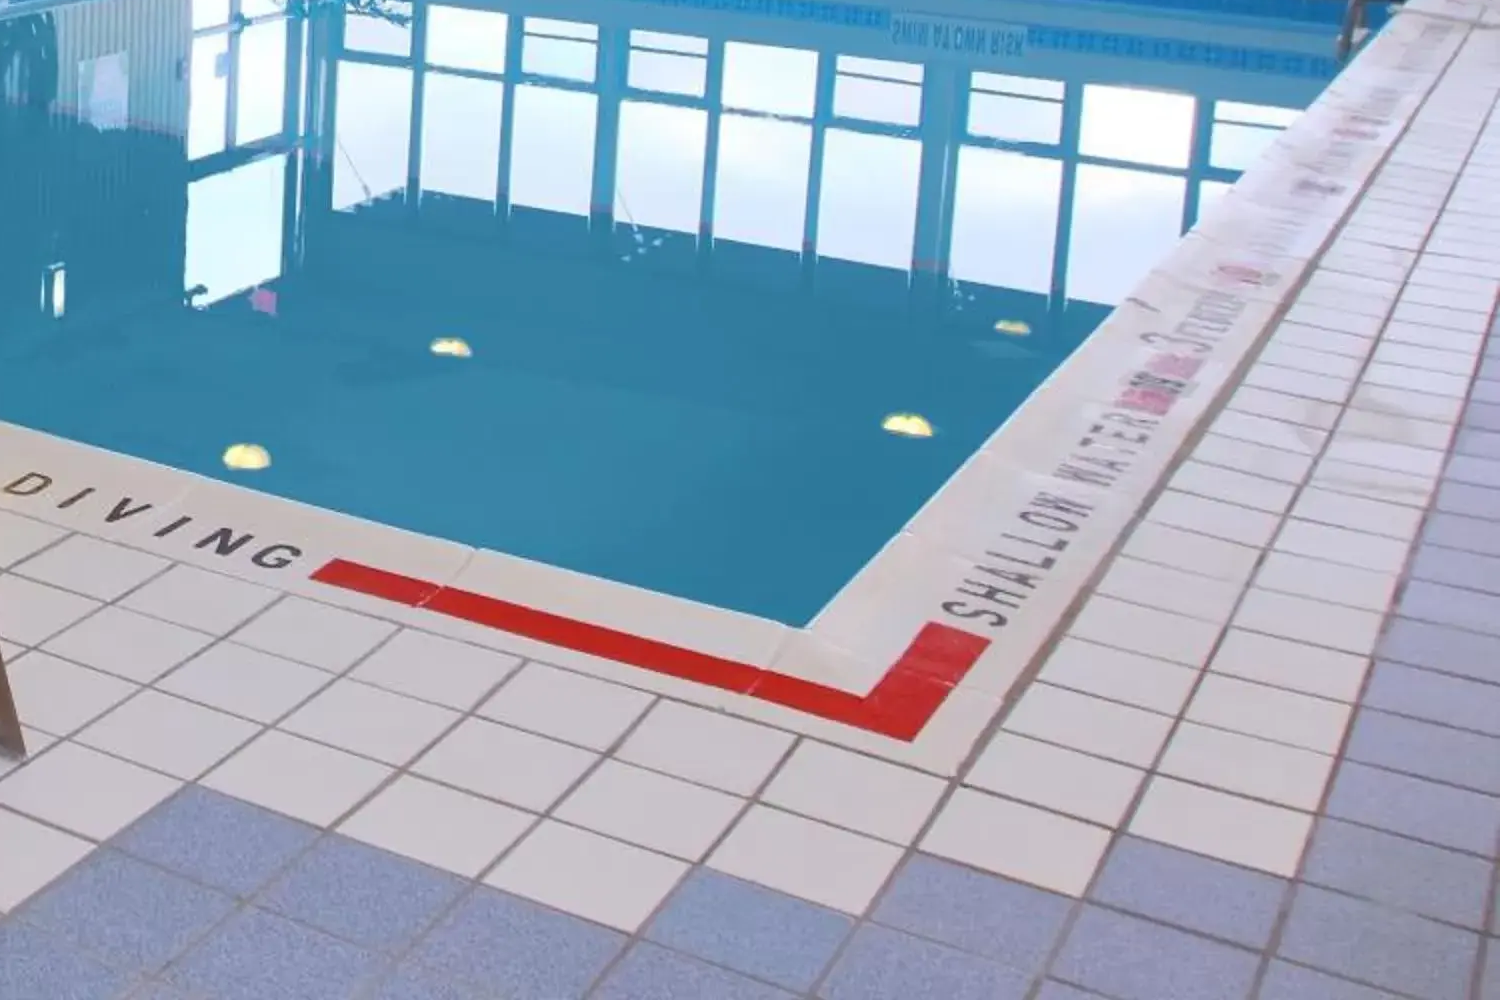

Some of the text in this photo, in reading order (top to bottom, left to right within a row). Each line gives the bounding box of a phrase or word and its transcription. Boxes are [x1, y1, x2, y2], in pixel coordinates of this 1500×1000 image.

[3, 471, 304, 569] DIVING
[941, 490, 1095, 629] SHALLOW
[1053, 411, 1160, 487] WATER
